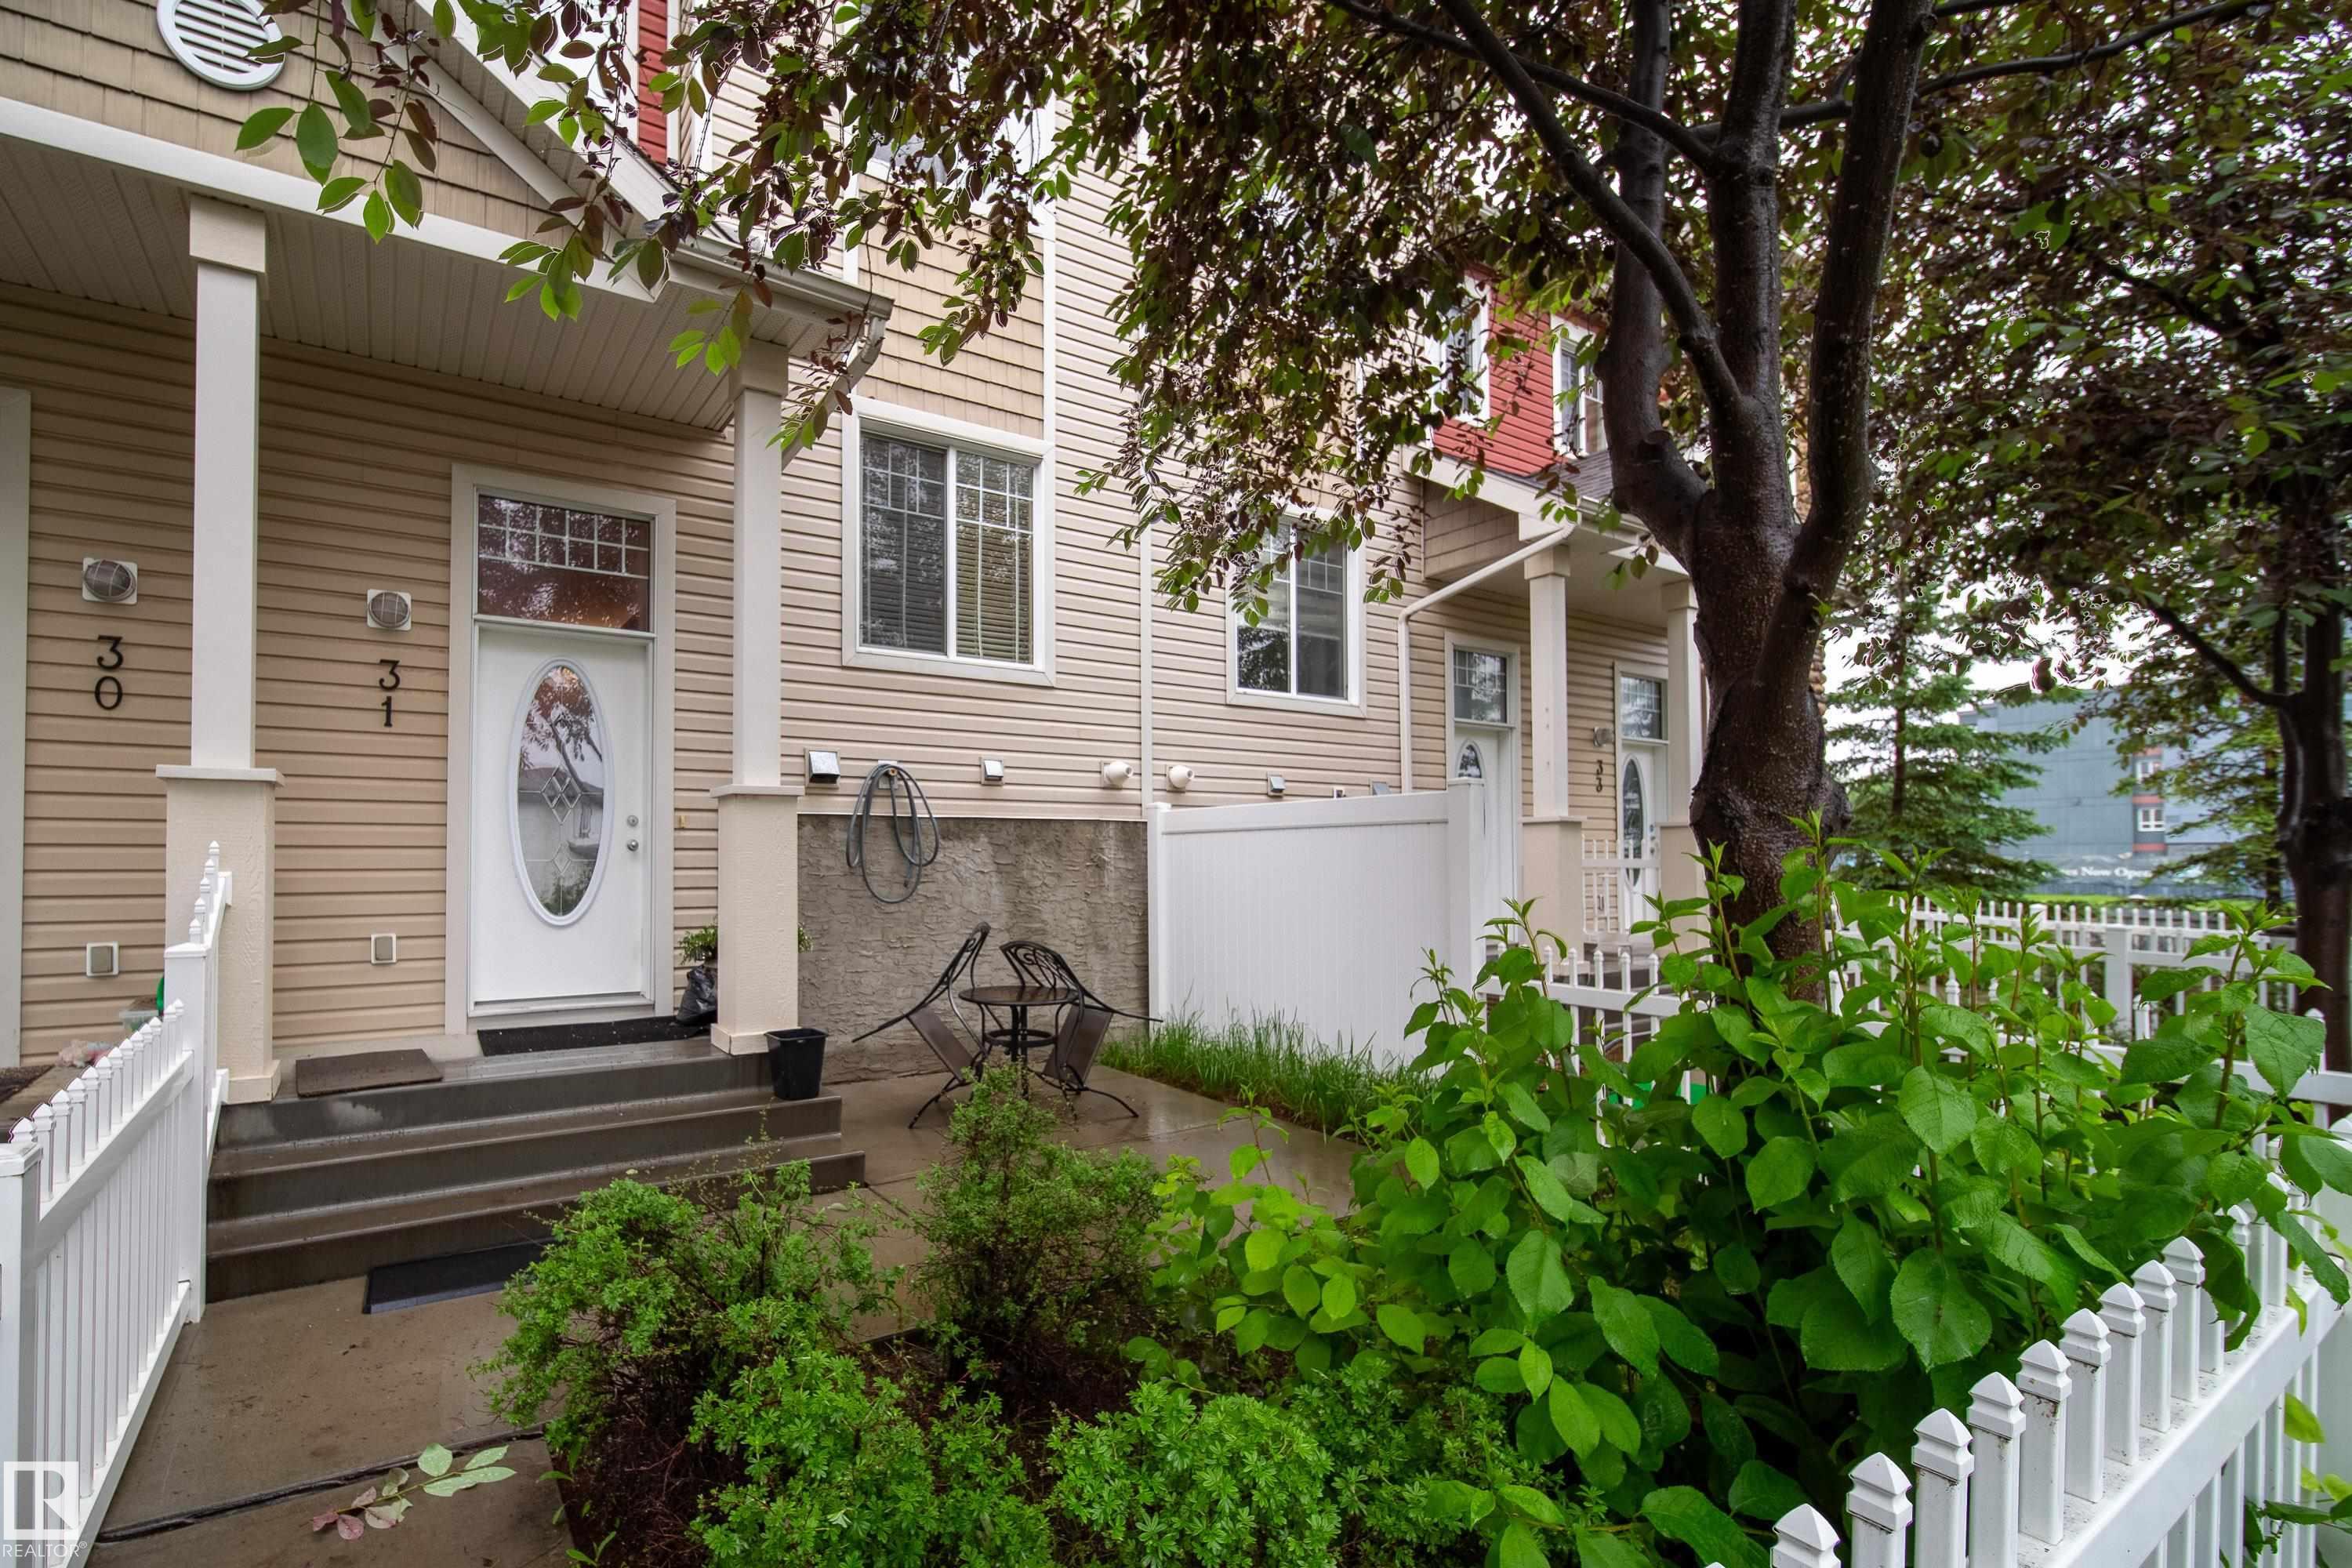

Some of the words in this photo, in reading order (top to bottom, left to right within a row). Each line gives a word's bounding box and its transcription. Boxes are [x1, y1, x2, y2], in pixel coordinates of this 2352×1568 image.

[95, 635, 123, 710] 30
[379, 659, 400, 728] 31
[2080, 866, 2111, 877] Now
